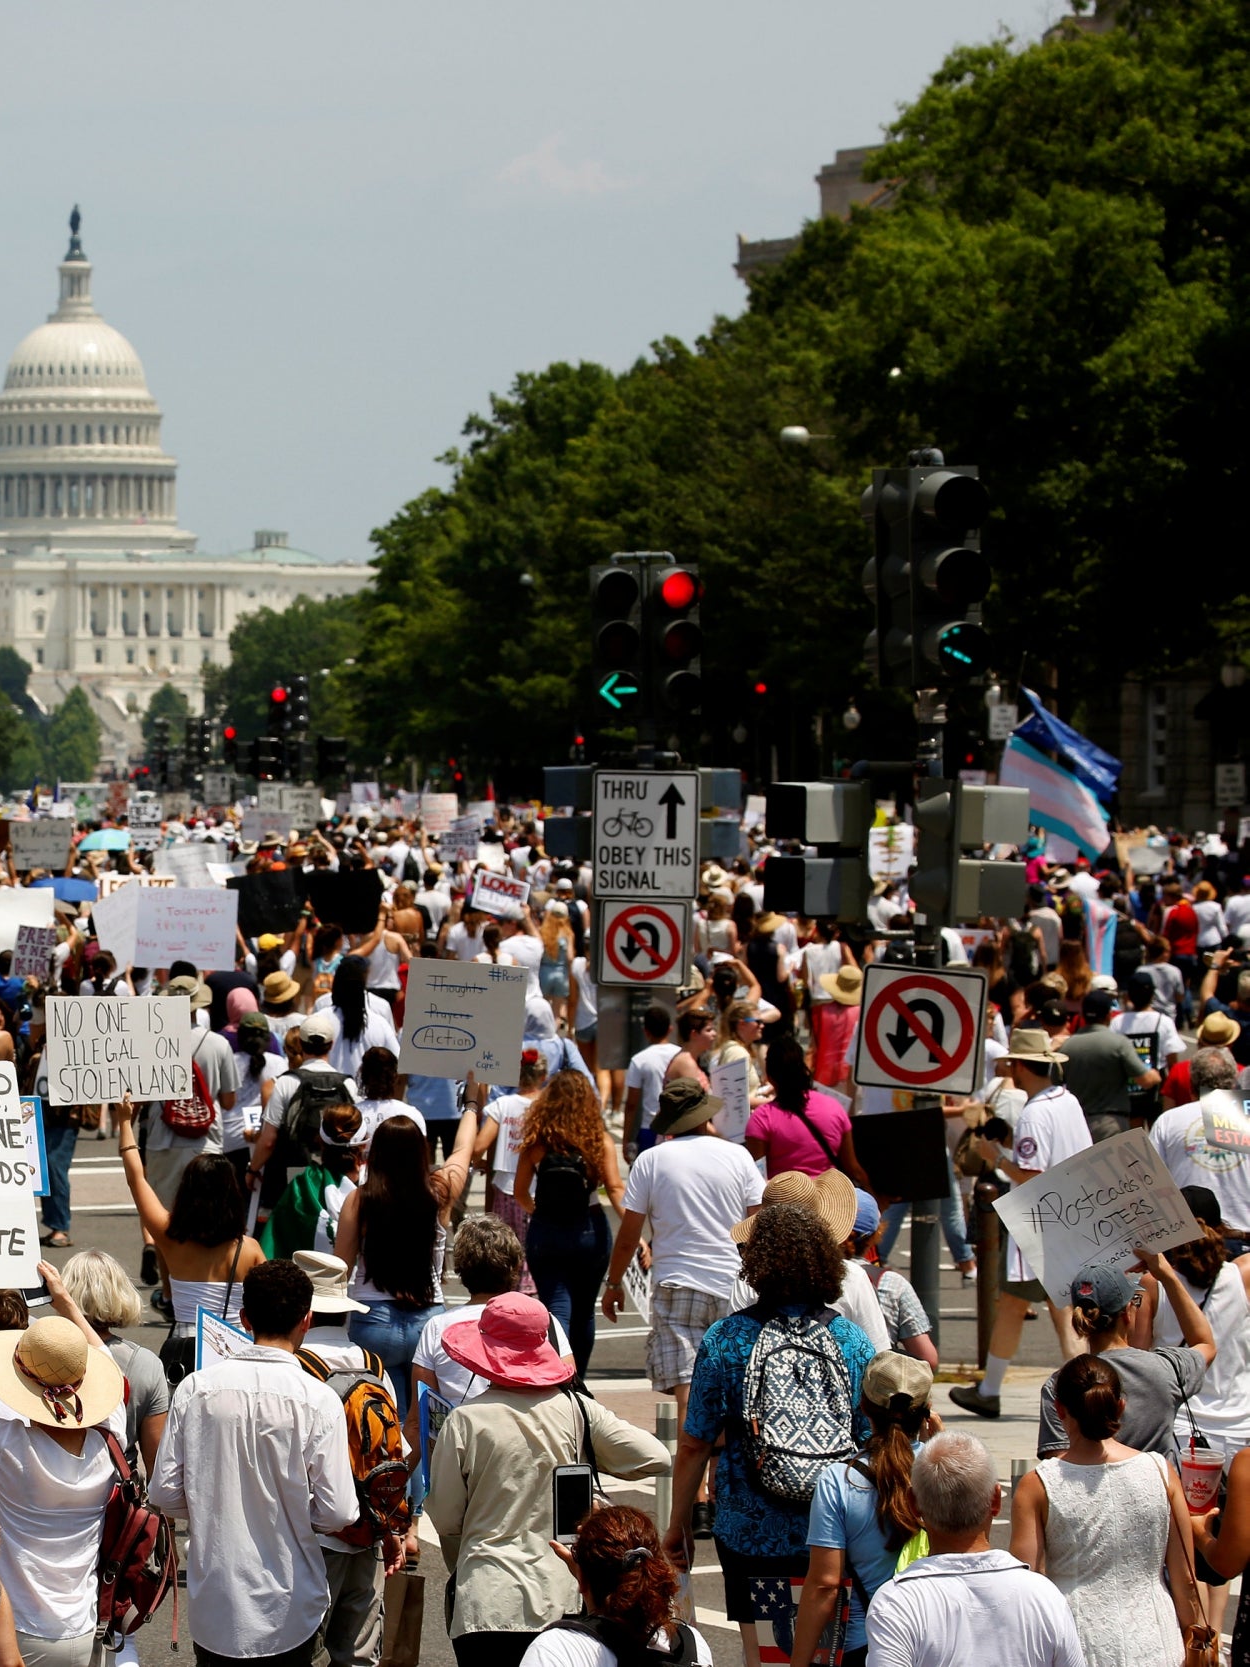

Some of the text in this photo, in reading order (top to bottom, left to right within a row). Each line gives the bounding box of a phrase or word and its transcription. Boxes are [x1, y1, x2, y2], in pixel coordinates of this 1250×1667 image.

[601, 780, 648, 800] THRU
[599, 846, 692, 867] OBEY THIS
[481, 875, 523, 899] LOVE
[599, 870, 661, 891] SIGNAL
[18, 926, 56, 946] FREE
[17, 944, 49, 958] THE
[54, 1001, 164, 1038] NO ONE IS
[423, 1027, 472, 1047] Action
[63, 1036, 180, 1067] ILLEGAL ON
[482, 1050, 494, 1061] We
[59, 1065, 133, 1103] STOLEN
[137, 1064, 188, 1097] LAND
[1214, 1128, 1250, 1147] ESTA
[1081, 1199, 1154, 1247] VOTERS
